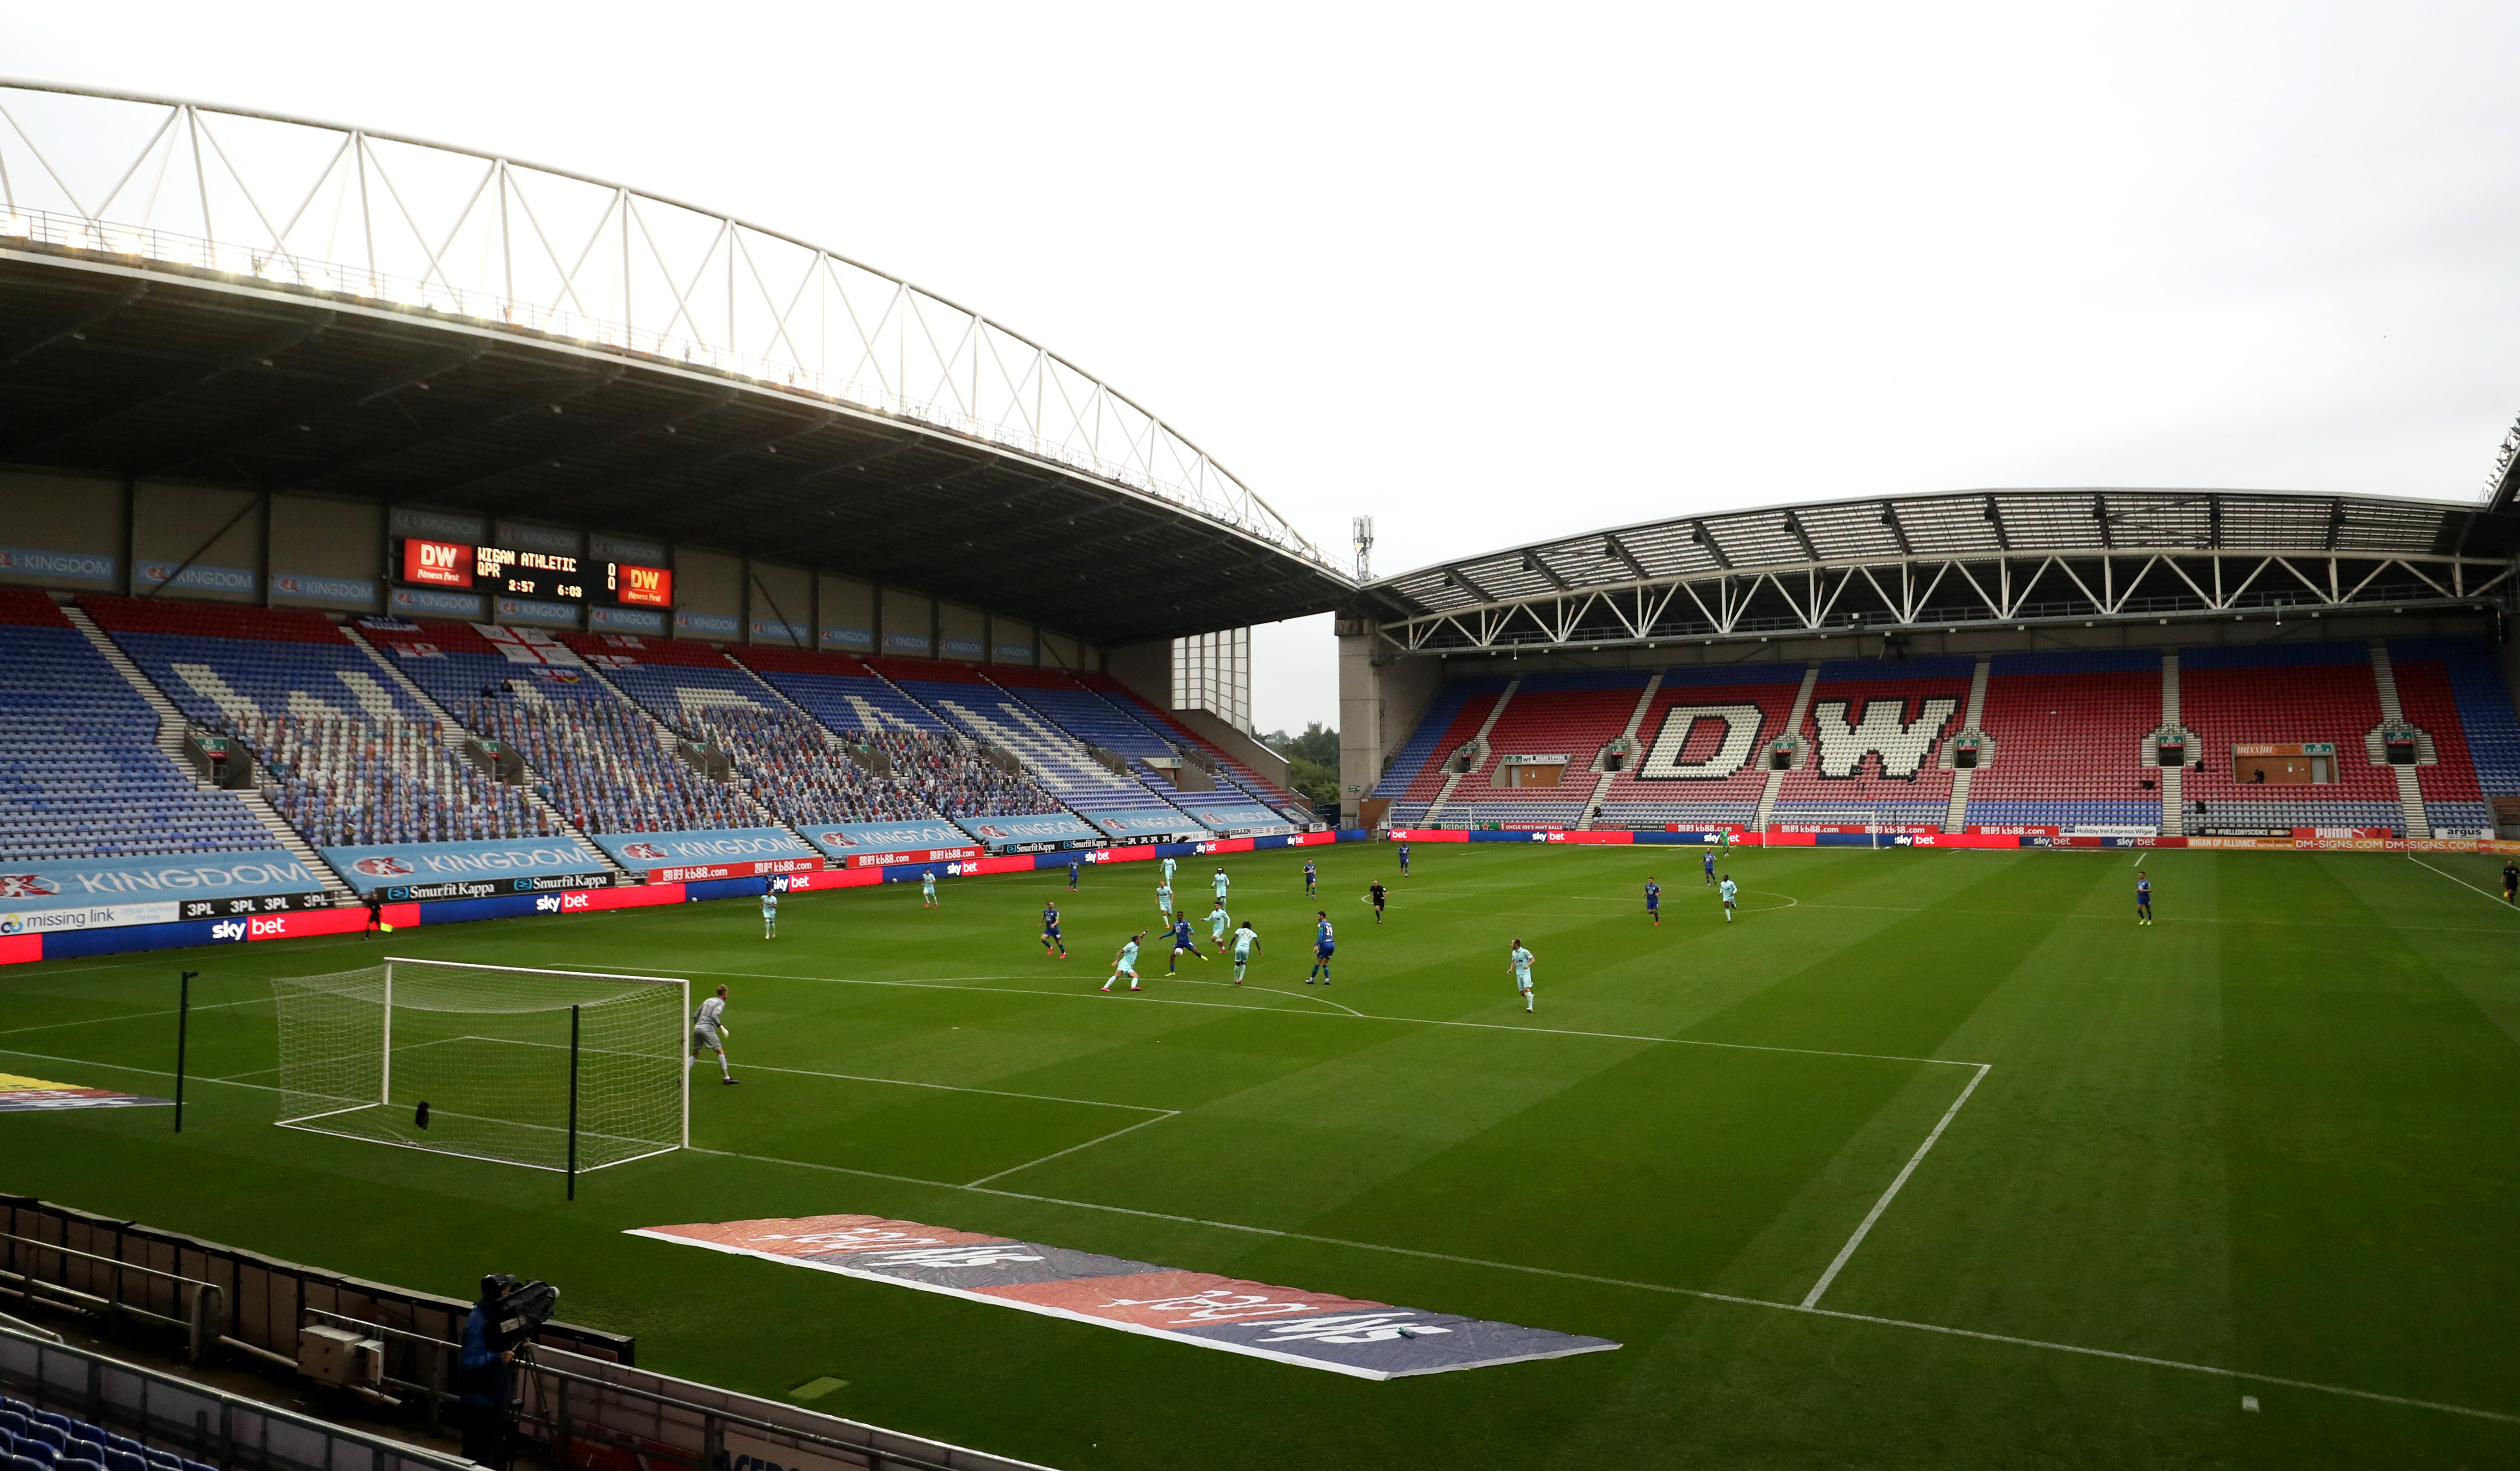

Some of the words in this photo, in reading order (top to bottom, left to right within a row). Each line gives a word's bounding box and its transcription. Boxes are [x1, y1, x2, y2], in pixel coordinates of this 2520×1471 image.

[421, 544, 457, 568] DW
[477, 546, 515, 566] WIGAN
[520, 552, 577, 573] ATHLETIC
[607, 563, 616, 577] 0
[25, 554, 111, 575] KINGDOM
[176, 570, 252, 588] KINGDOM
[417, 568, 443, 580] Fitness
[444, 572, 460, 582] First
[477, 561, 501, 578] QPR
[607, 576, 616, 591] 0
[630, 568, 659, 590] DW
[306, 581, 373, 599] KINGDOM
[508, 579, 535, 593] 2:57
[557, 584, 582, 598] 6:03
[420, 595, 479, 610] KINGDOM
[628, 591, 648, 601] Fitness
[649, 593, 661, 602] First
[523, 604, 575, 618] KINGDOM
[613, 612, 661, 625] KINGDOM
[694, 619, 737, 631] KINGDOM
[768, 625, 807, 637] KINGOM
[835, 631, 869, 642] KINGDOM
[895, 637, 928, 649] KINGDOM
[951, 643, 982, 653] KINGDOM
[1001, 647, 1031, 656] KINGDOM
[1635, 699, 1957, 779] DW
[1125, 815, 1196, 828] KINGDOM
[1222, 810, 1285, 823] KINGDOM
[1007, 821, 1093, 836] KINGDOM
[2315, 828, 2352, 839] PUMA
[859, 827, 967, 845] KINGDOM
[1287, 836, 1295, 846] sky
[1532, 832, 1547, 841] sky
[1549, 832, 1564, 840] bet
[1704, 833, 1720, 843] sky
[1895, 835, 1912, 846] sky
[1915, 835, 1935, 844] bet
[2034, 837, 2050, 846] sky
[2117, 837, 2134, 847] sky
[2137, 837, 2156, 846] bet
[670, 837, 804, 857] KINGDOM
[1038, 843, 1055, 853] Kappa
[1092, 839, 1107, 848] Kappa
[1196, 843, 1205, 853] sky
[1206, 843, 1216, 851] bet
[2189, 839, 2211, 847] WIGAN
[2212, 839, 2222, 847] GP
[2385, 840, 2477, 849] DM-SIGNS.COM
[422, 847, 594, 872] KINGDOM
[876, 853, 910, 865] kb88.com
[945, 847, 975, 860] kb88.com
[1085, 851, 1097, 863] sky
[1097, 851, 1110, 861] bet
[773, 860, 813, 872] kb88.com
[947, 863, 961, 876] sky
[963, 862, 978, 872] bet
[76, 862, 312, 894] KINGDOM
[685, 867, 728, 879] kb88.com
[533, 876, 574, 889] Smurfit
[574, 874, 607, 891] Kappa
[791, 875, 810, 888] bet
[409, 885, 457, 899] Smurfit
[457, 882, 495, 898] Kappa
[187, 903, 215, 917] 3PL
[230, 899, 256, 913] 3PL
[264, 897, 290, 911] 3PL
[303, 894, 328, 908] 3PL
[536, 895, 561, 912] sky
[564, 894, 589, 908] bet
[27, 911, 86, 927] missing
[90, 907, 115, 923] link
[212, 920, 247, 941] sky
[252, 917, 286, 935] bet
[1325, 926, 1333, 936] 19
